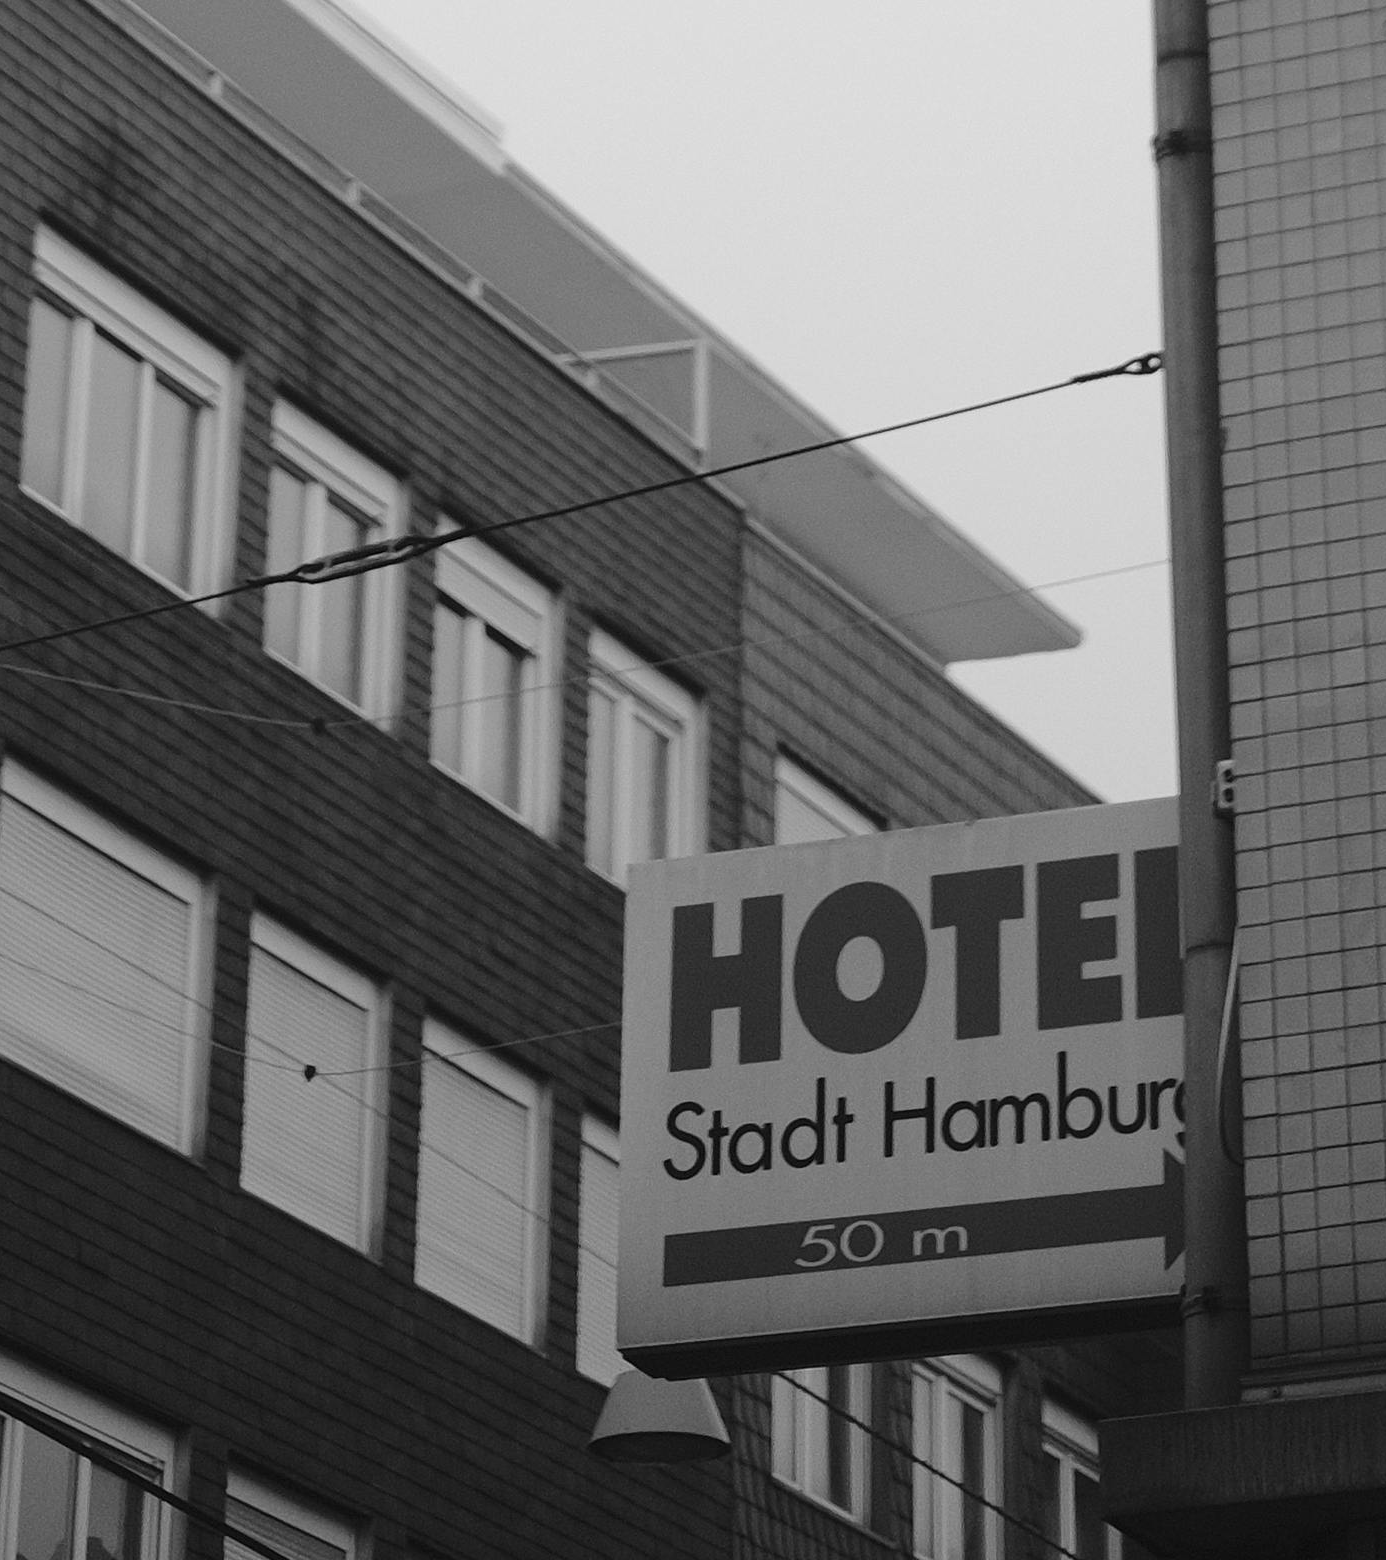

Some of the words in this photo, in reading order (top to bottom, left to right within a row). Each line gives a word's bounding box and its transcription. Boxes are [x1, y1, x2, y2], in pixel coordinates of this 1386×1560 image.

[663, 1077, 854, 1180] Stadt
[794, 1220, 884, 1268] 50
[912, 1224, 969, 1256] m
